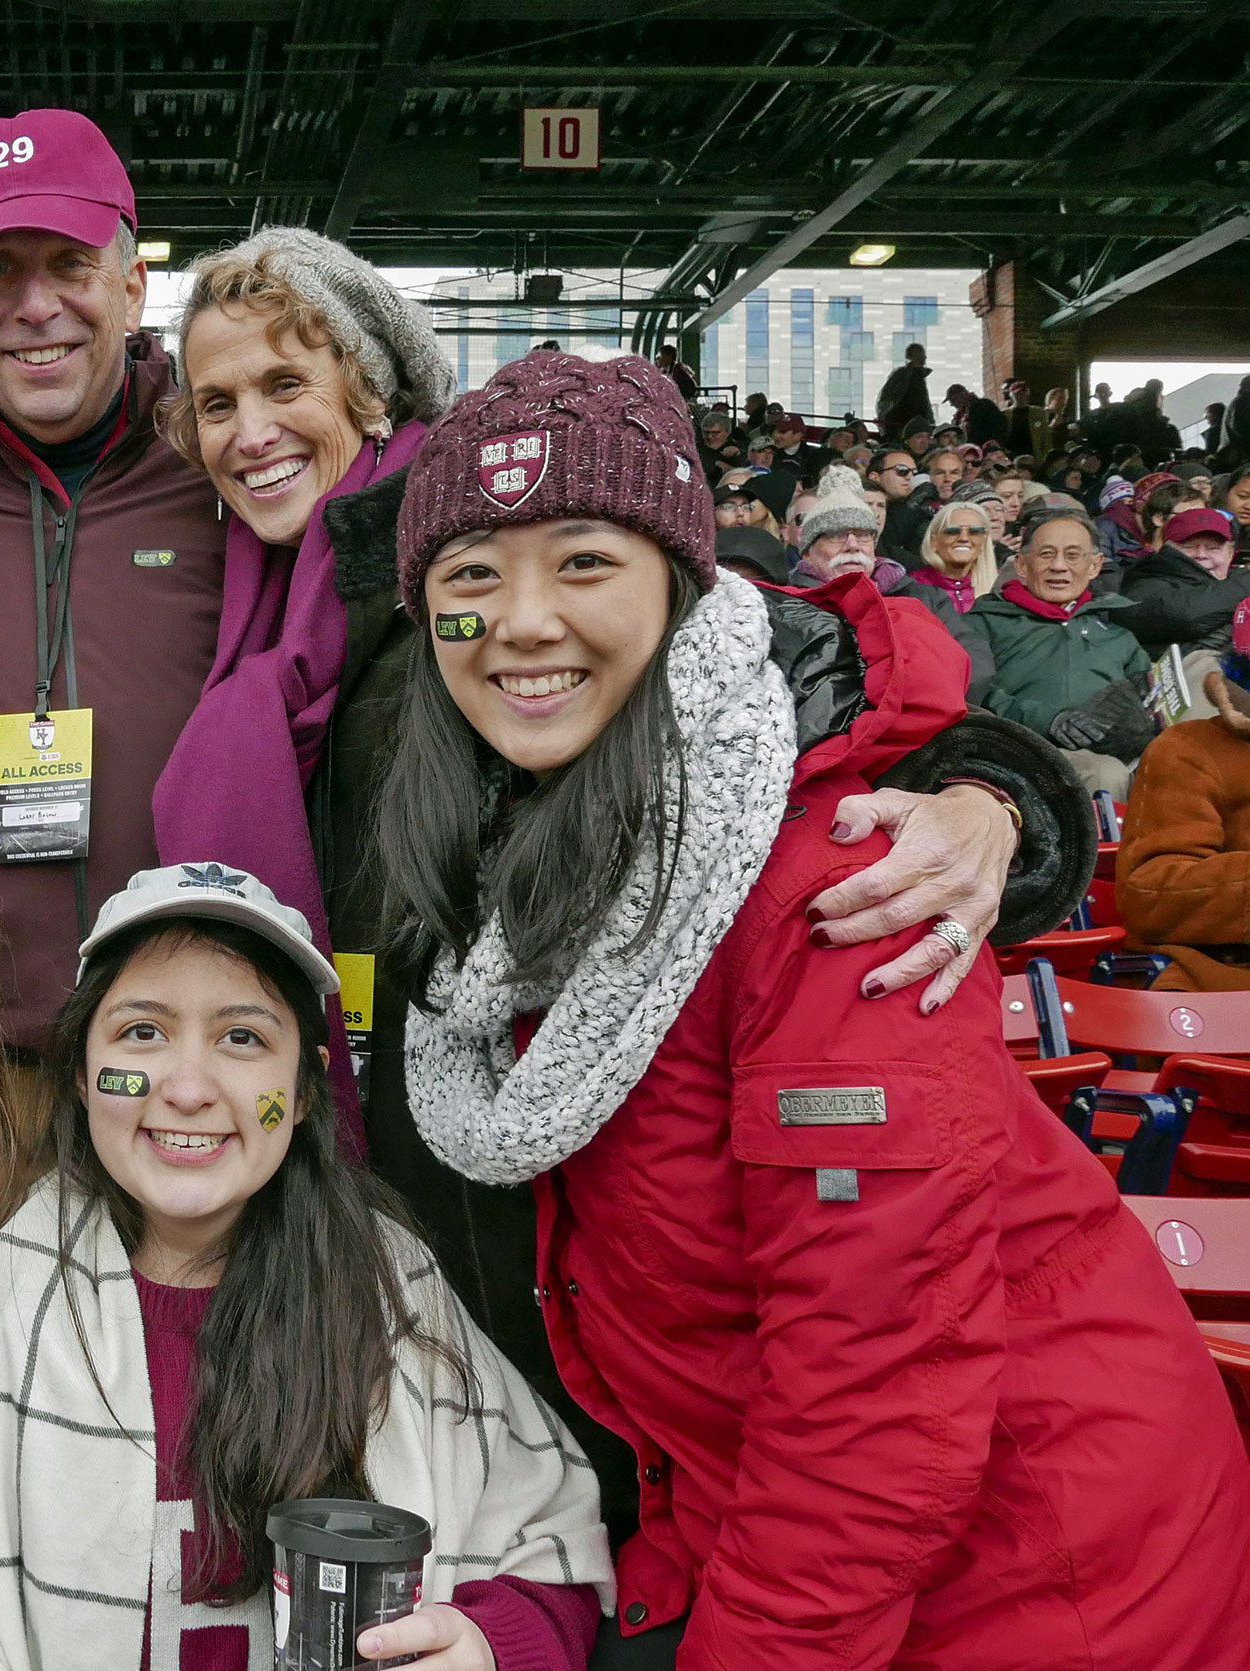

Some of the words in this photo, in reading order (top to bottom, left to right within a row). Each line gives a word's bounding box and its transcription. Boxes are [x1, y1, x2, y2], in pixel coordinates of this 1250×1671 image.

[541, 116, 579, 159] 10
[437, 620, 457, 636] LEV
[1165, 686, 1181, 716] THE
[2, 766, 26, 779] ALL
[29, 762, 83, 777] ACCESS
[177, 880, 247, 899] adidas
[1179, 1014, 1194, 1031] 2
[99, 1074, 125, 1091] LEV
[779, 1094, 885, 1115] OBERMEYER
